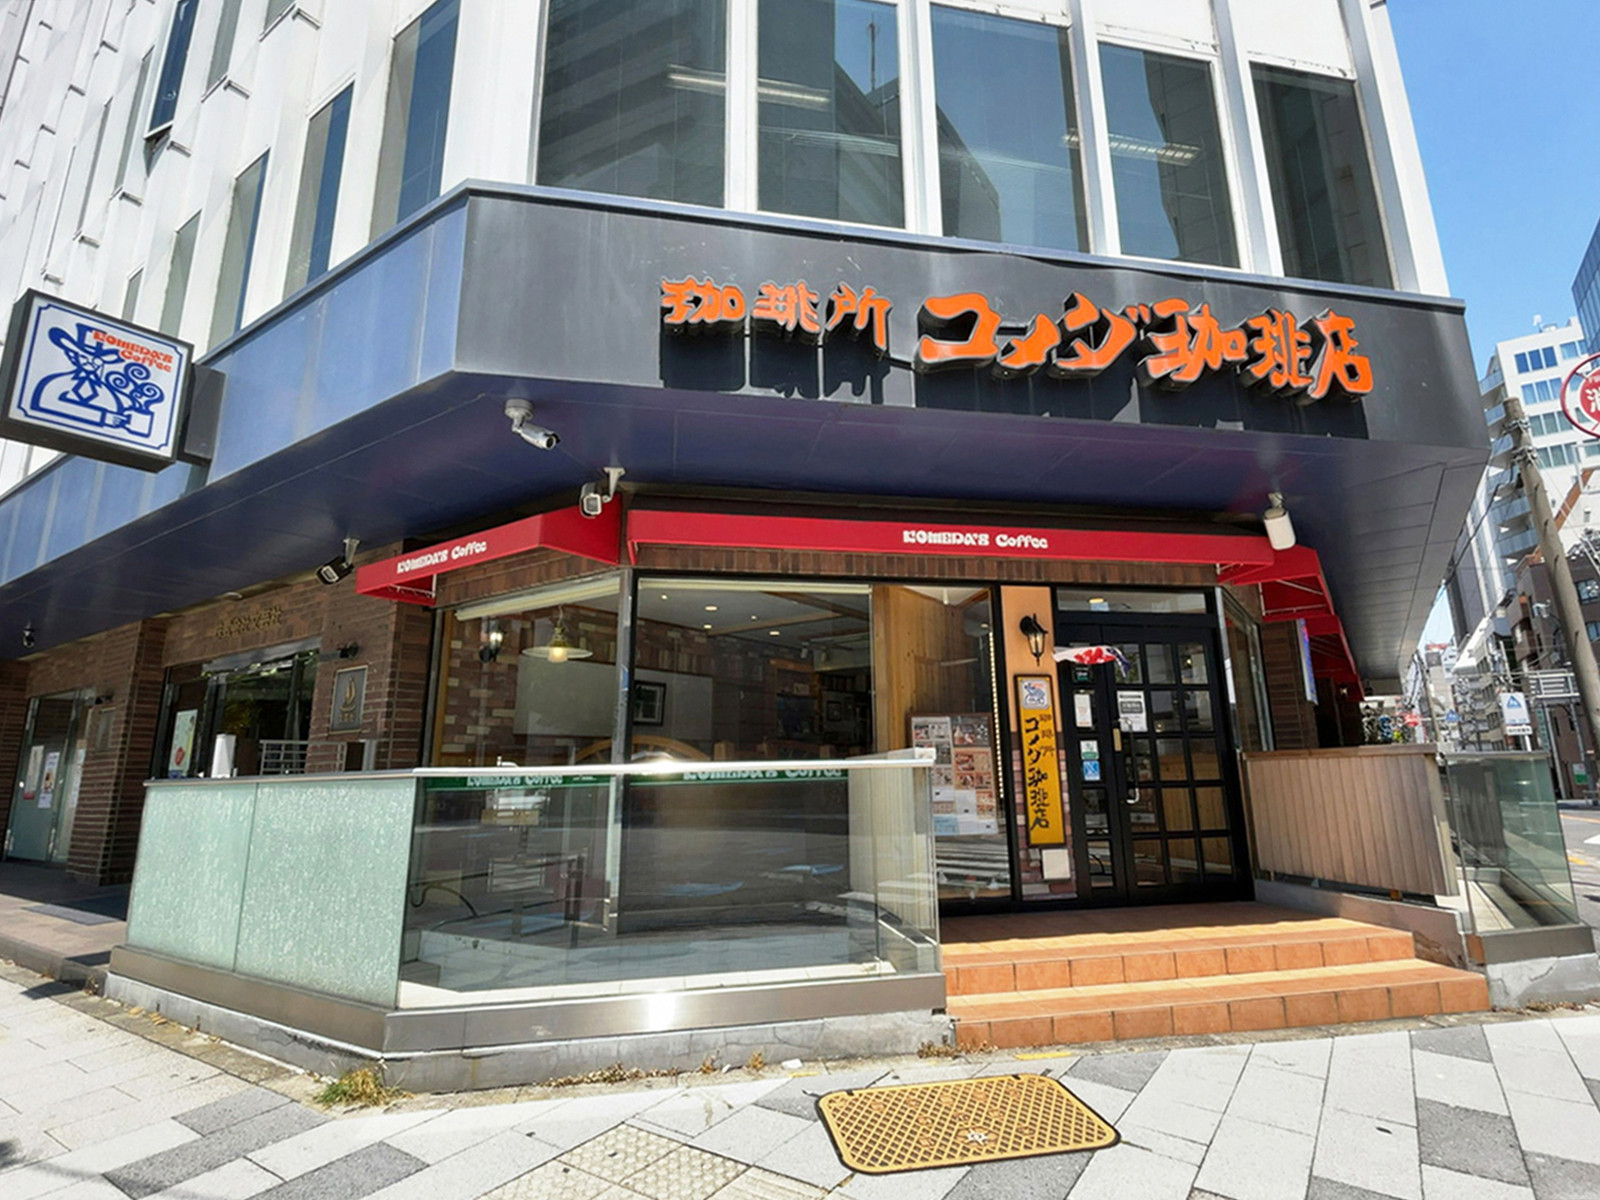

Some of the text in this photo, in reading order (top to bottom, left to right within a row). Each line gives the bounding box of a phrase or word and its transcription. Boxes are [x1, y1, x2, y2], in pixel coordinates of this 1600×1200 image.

[120, 349, 172, 372] Coffee
[902, 530, 1049, 549] KOMEDA'S Coffee
[451, 541, 487, 560] Coffee
